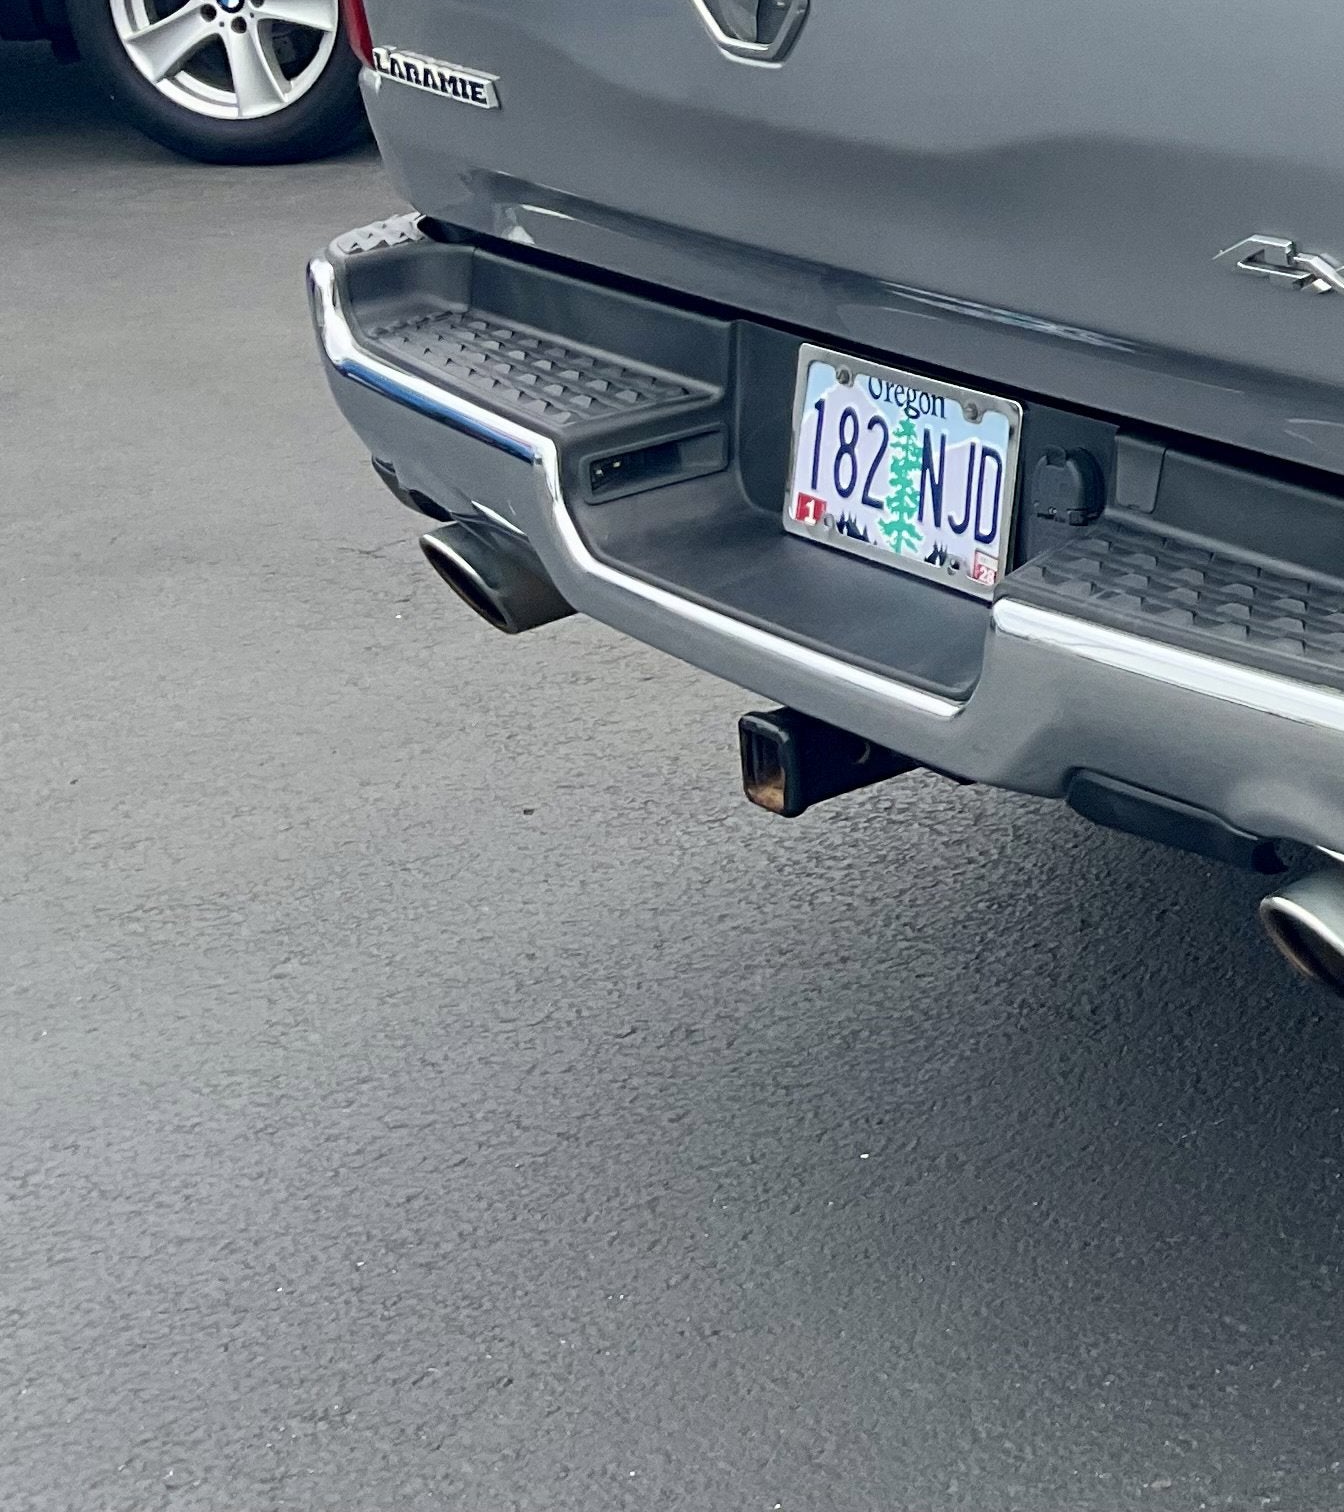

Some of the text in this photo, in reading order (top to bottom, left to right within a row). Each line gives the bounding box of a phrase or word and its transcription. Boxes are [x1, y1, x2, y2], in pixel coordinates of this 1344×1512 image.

[373, 48, 490, 107] LARAMIE
[868, 376, 946, 419] Oregon
[811, 398, 1002, 545] 182 NJD
